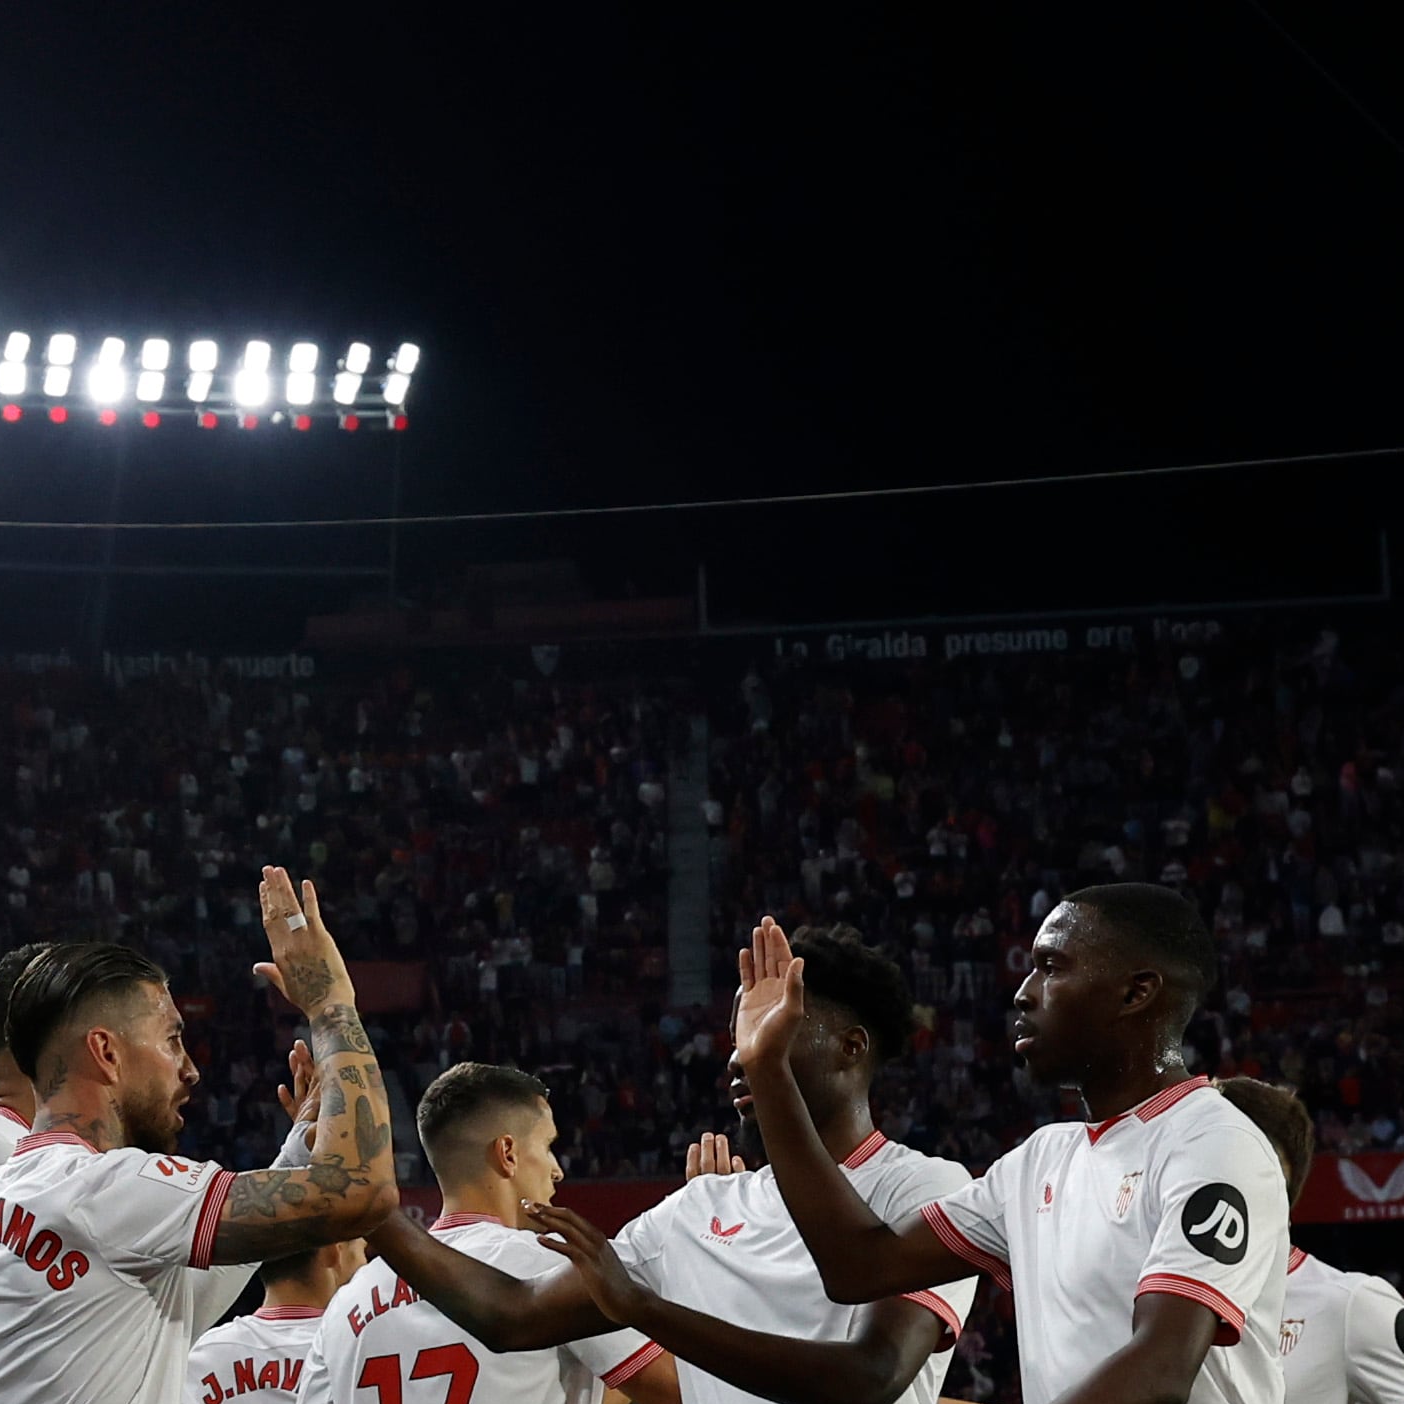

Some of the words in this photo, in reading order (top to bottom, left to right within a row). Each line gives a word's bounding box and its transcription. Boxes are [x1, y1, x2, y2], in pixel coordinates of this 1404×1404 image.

[944, 627, 1069, 661] presume
[1189, 1199, 1246, 1250] JD
[347, 1276, 424, 1338] E.LA
